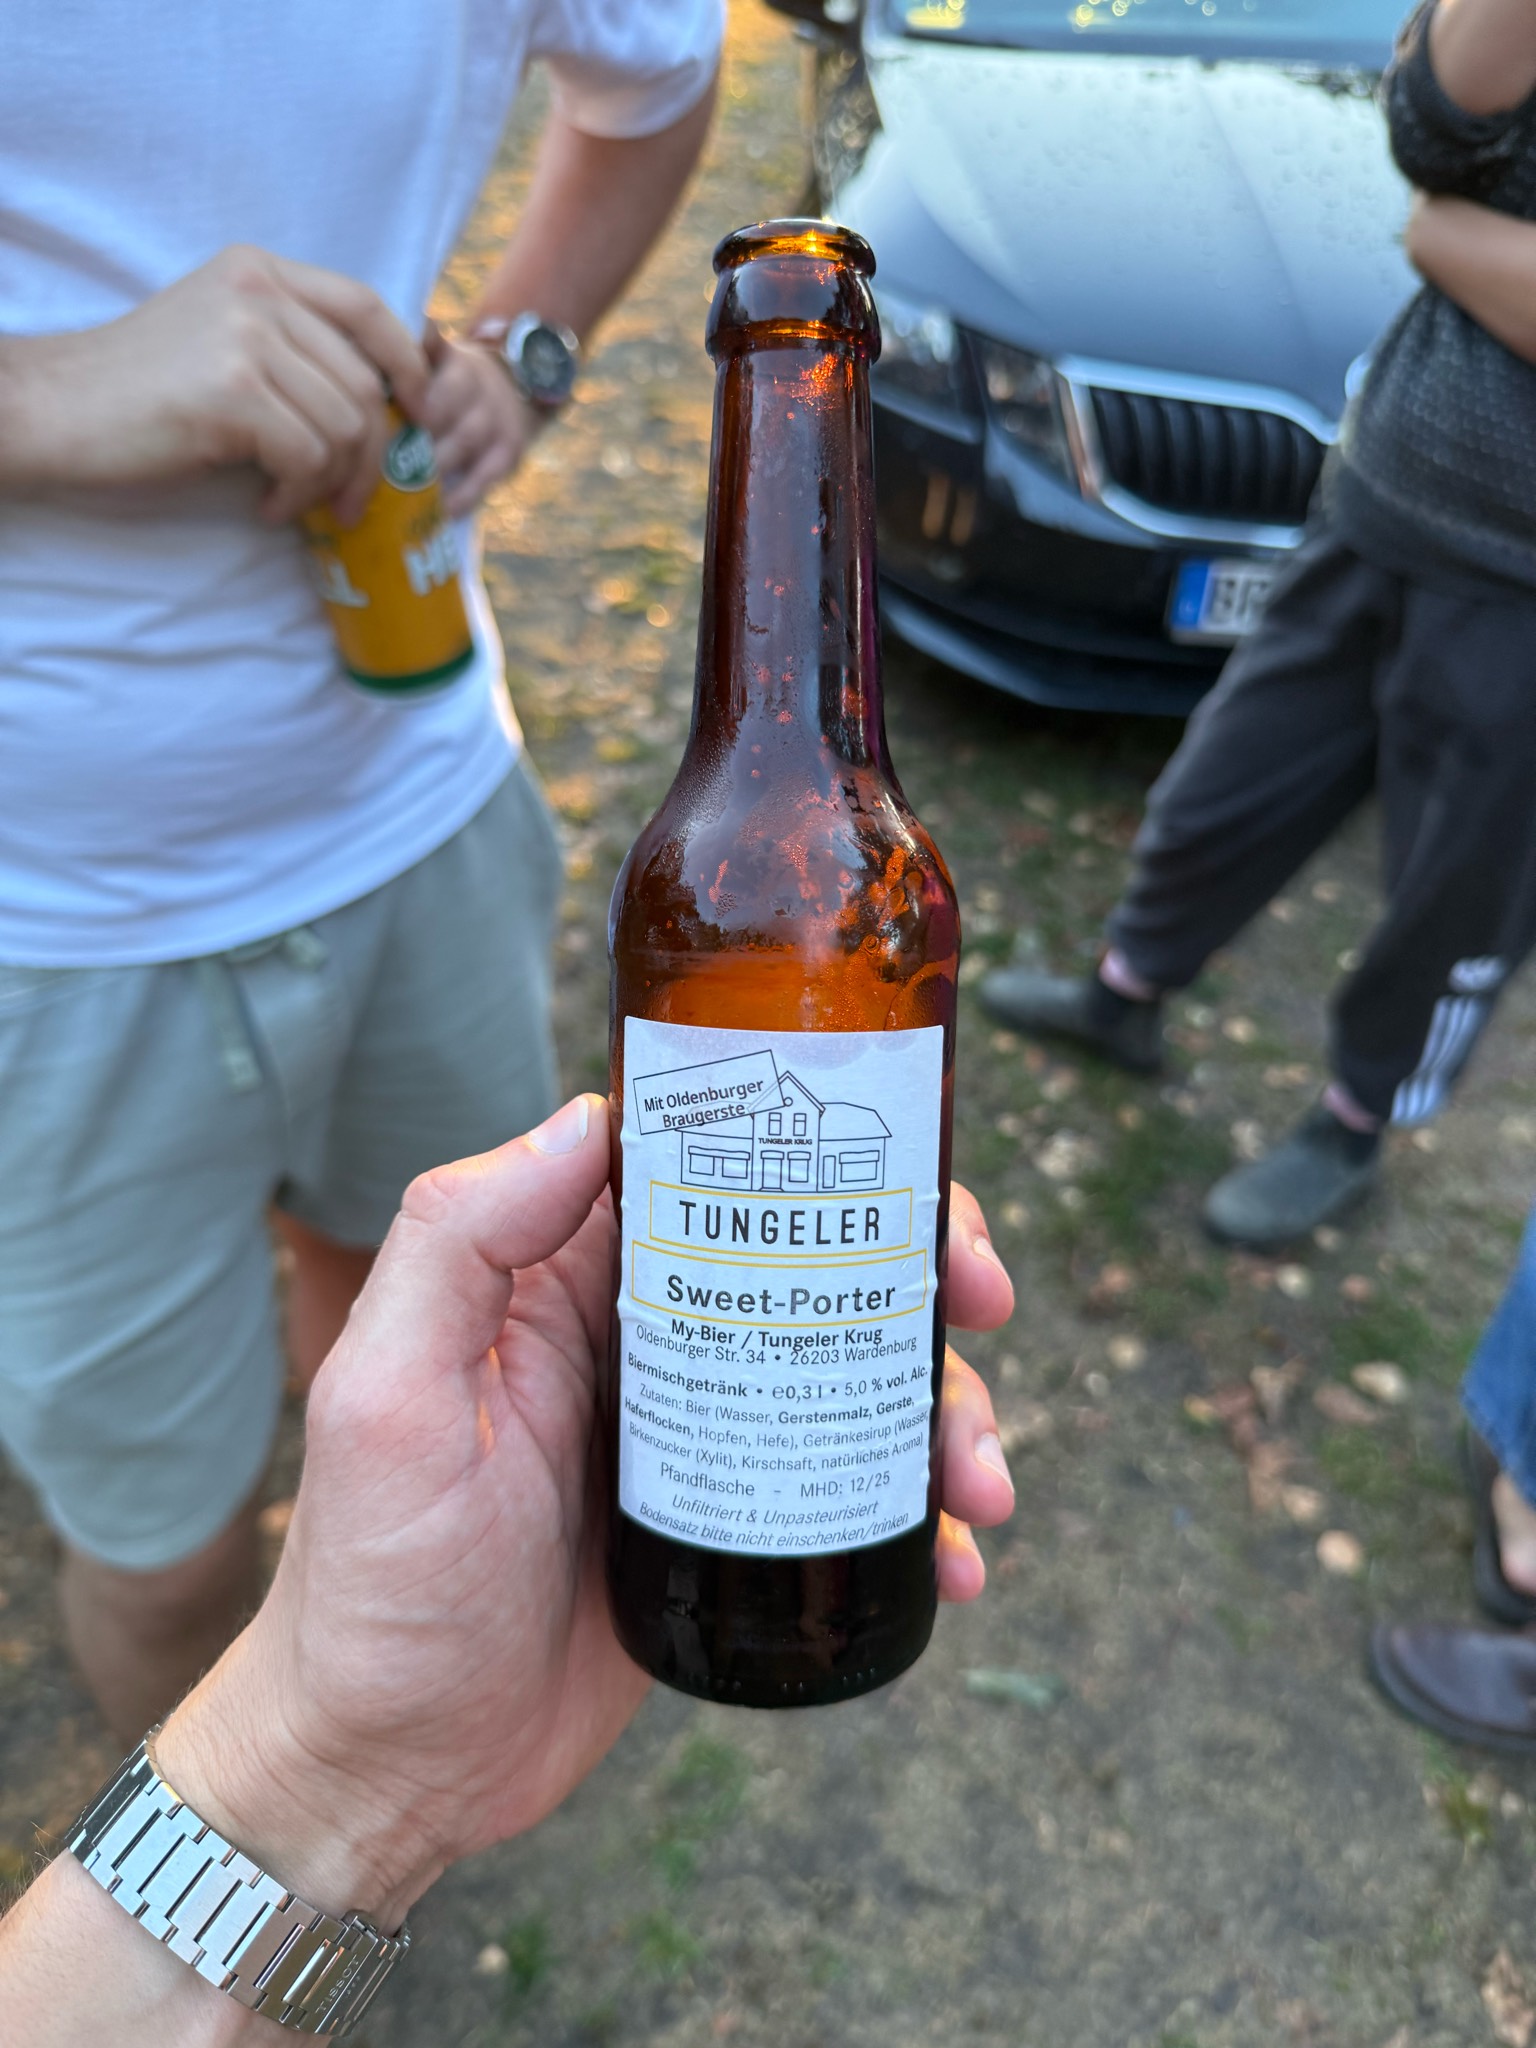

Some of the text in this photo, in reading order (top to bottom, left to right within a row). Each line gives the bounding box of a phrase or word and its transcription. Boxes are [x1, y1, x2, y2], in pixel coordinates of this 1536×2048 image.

[644, 1078, 764, 1113] Mit Oldenburger
[662, 1103, 746, 1128] Braugerste
[758, 1137, 793, 1145] TUNGELER
[679, 1200, 880, 1246] TUNGELER
[666, 1274, 896, 1315] Sweet-Porter
[636, 1324, 711, 1360] Oldenburger
[715, 1345, 740, 1363] Str.
[745, 1350, 766, 1364] 34
[790, 1349, 840, 1365] 26203
[844, 1335, 917, 1363] Wardenburg
[671, 1318, 736, 1345] My-Bier
[758, 1331, 839, 1351] Tungeler
[844, 1327, 883, 1345] Krug
[627, 1352, 748, 1397] Biermischgetränk
[844, 1380, 867, 1397] 5,0
[871, 1377, 882, 1392] %
[886, 1370, 907, 1389] vol.
[910, 1365, 928, 1383] Alc.
[624, 1396, 694, 1440] Haferflocken,
[698, 1425, 751, 1448] Hopfen,
[756, 1433, 798, 1450] Hefe),
[803, 1424, 892, 1448] Getränkesirup
[639, 1383, 914, 1426] Zutaten: Bier (Wasser, Gerstenmalz, Gerste,
[629, 1421, 692, 1458] Birkenzucker
[696, 1448, 737, 1470] (Xylit),
[741, 1455, 817, 1472] Kirschsaft,
[821, 1446, 890, 1470] natürliches
[660, 1461, 756, 1497] Pfandflasche
[800, 1480, 844, 1498] MHD:
[850, 1470, 891, 1495] 12/25
[639, 1501, 909, 1547] Bodensatz bitte nicht einschenken/trinken
[672, 1494, 879, 1528] Unfiltriert & Unpasteurisiert
[315, 1954, 359, 2014] TISSOT
